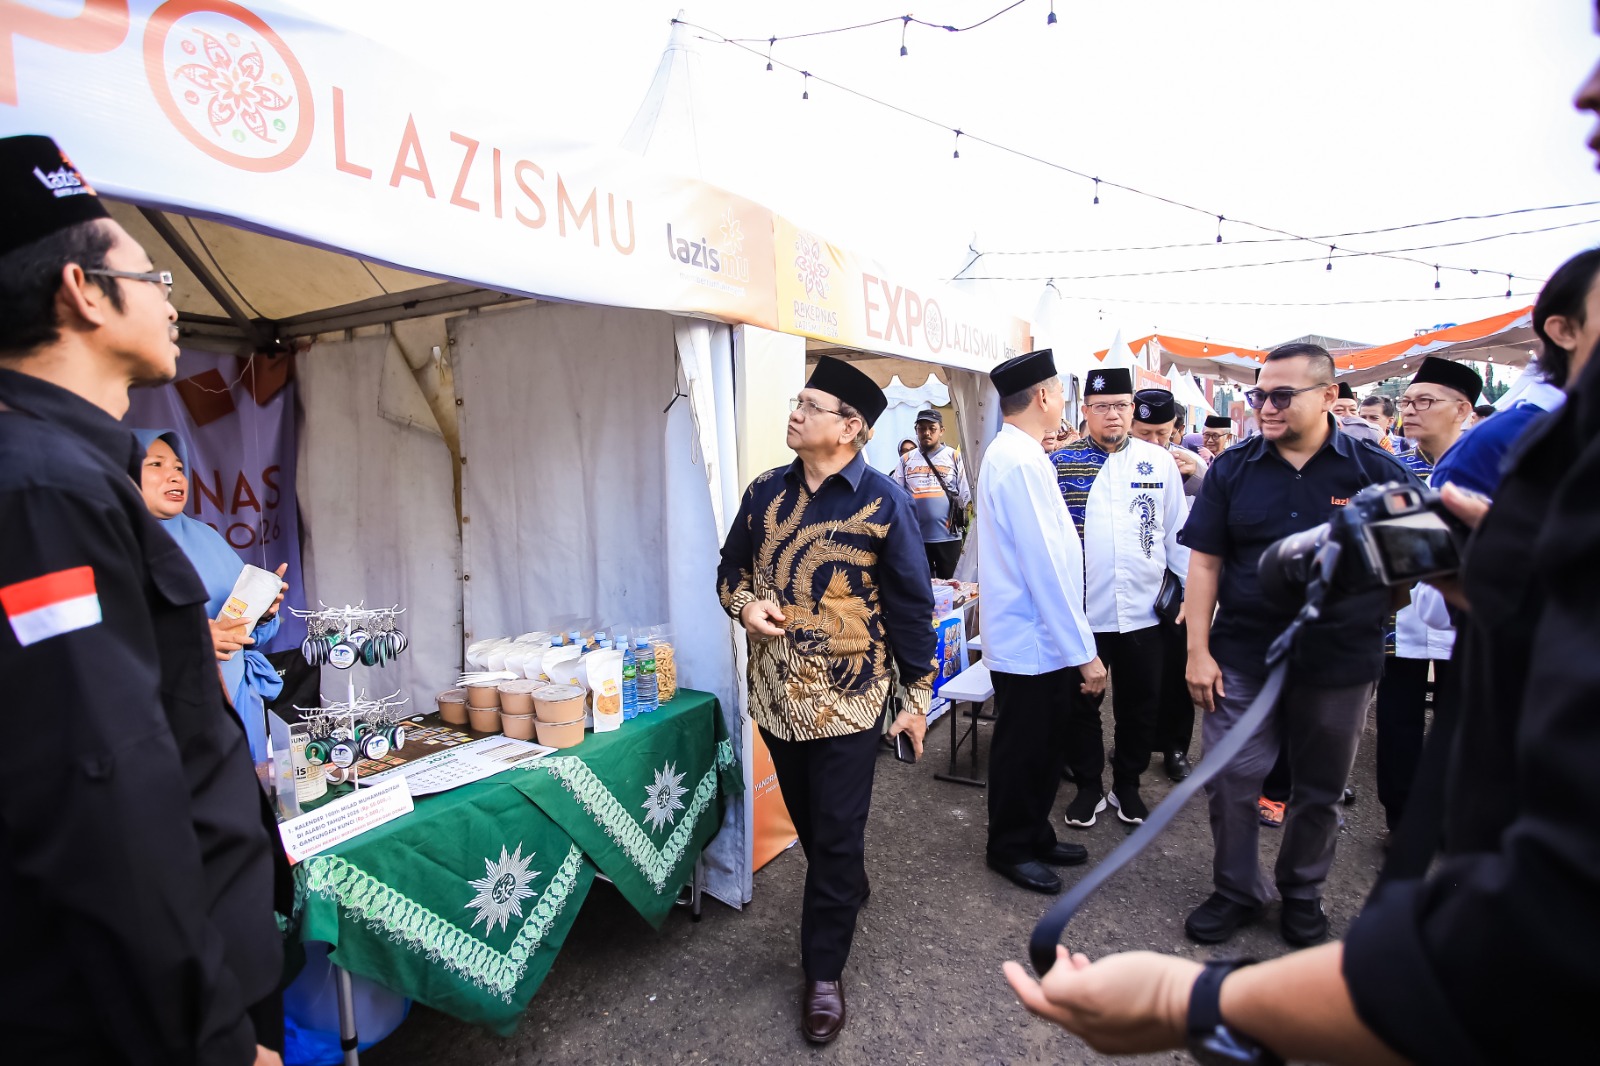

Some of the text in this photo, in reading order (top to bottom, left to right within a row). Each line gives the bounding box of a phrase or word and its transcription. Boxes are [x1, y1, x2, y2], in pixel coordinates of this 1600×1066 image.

[332, 86, 636, 256] LAZISMU
[793, 300, 838, 327] RAKERNAS
[862, 272, 998, 361] EXPO LAZISMU
[206, 515, 280, 549] 026
[294, 815, 323, 831] KALENDER
[341, 801, 357, 811] MILAD
[304, 823, 325, 835] ALABIO
[327, 814, 345, 825] TAHUN
[347, 808, 359, 817] 2026
[299, 827, 336, 846] GANTUNGAN
[337, 819, 354, 830] KUNCI
